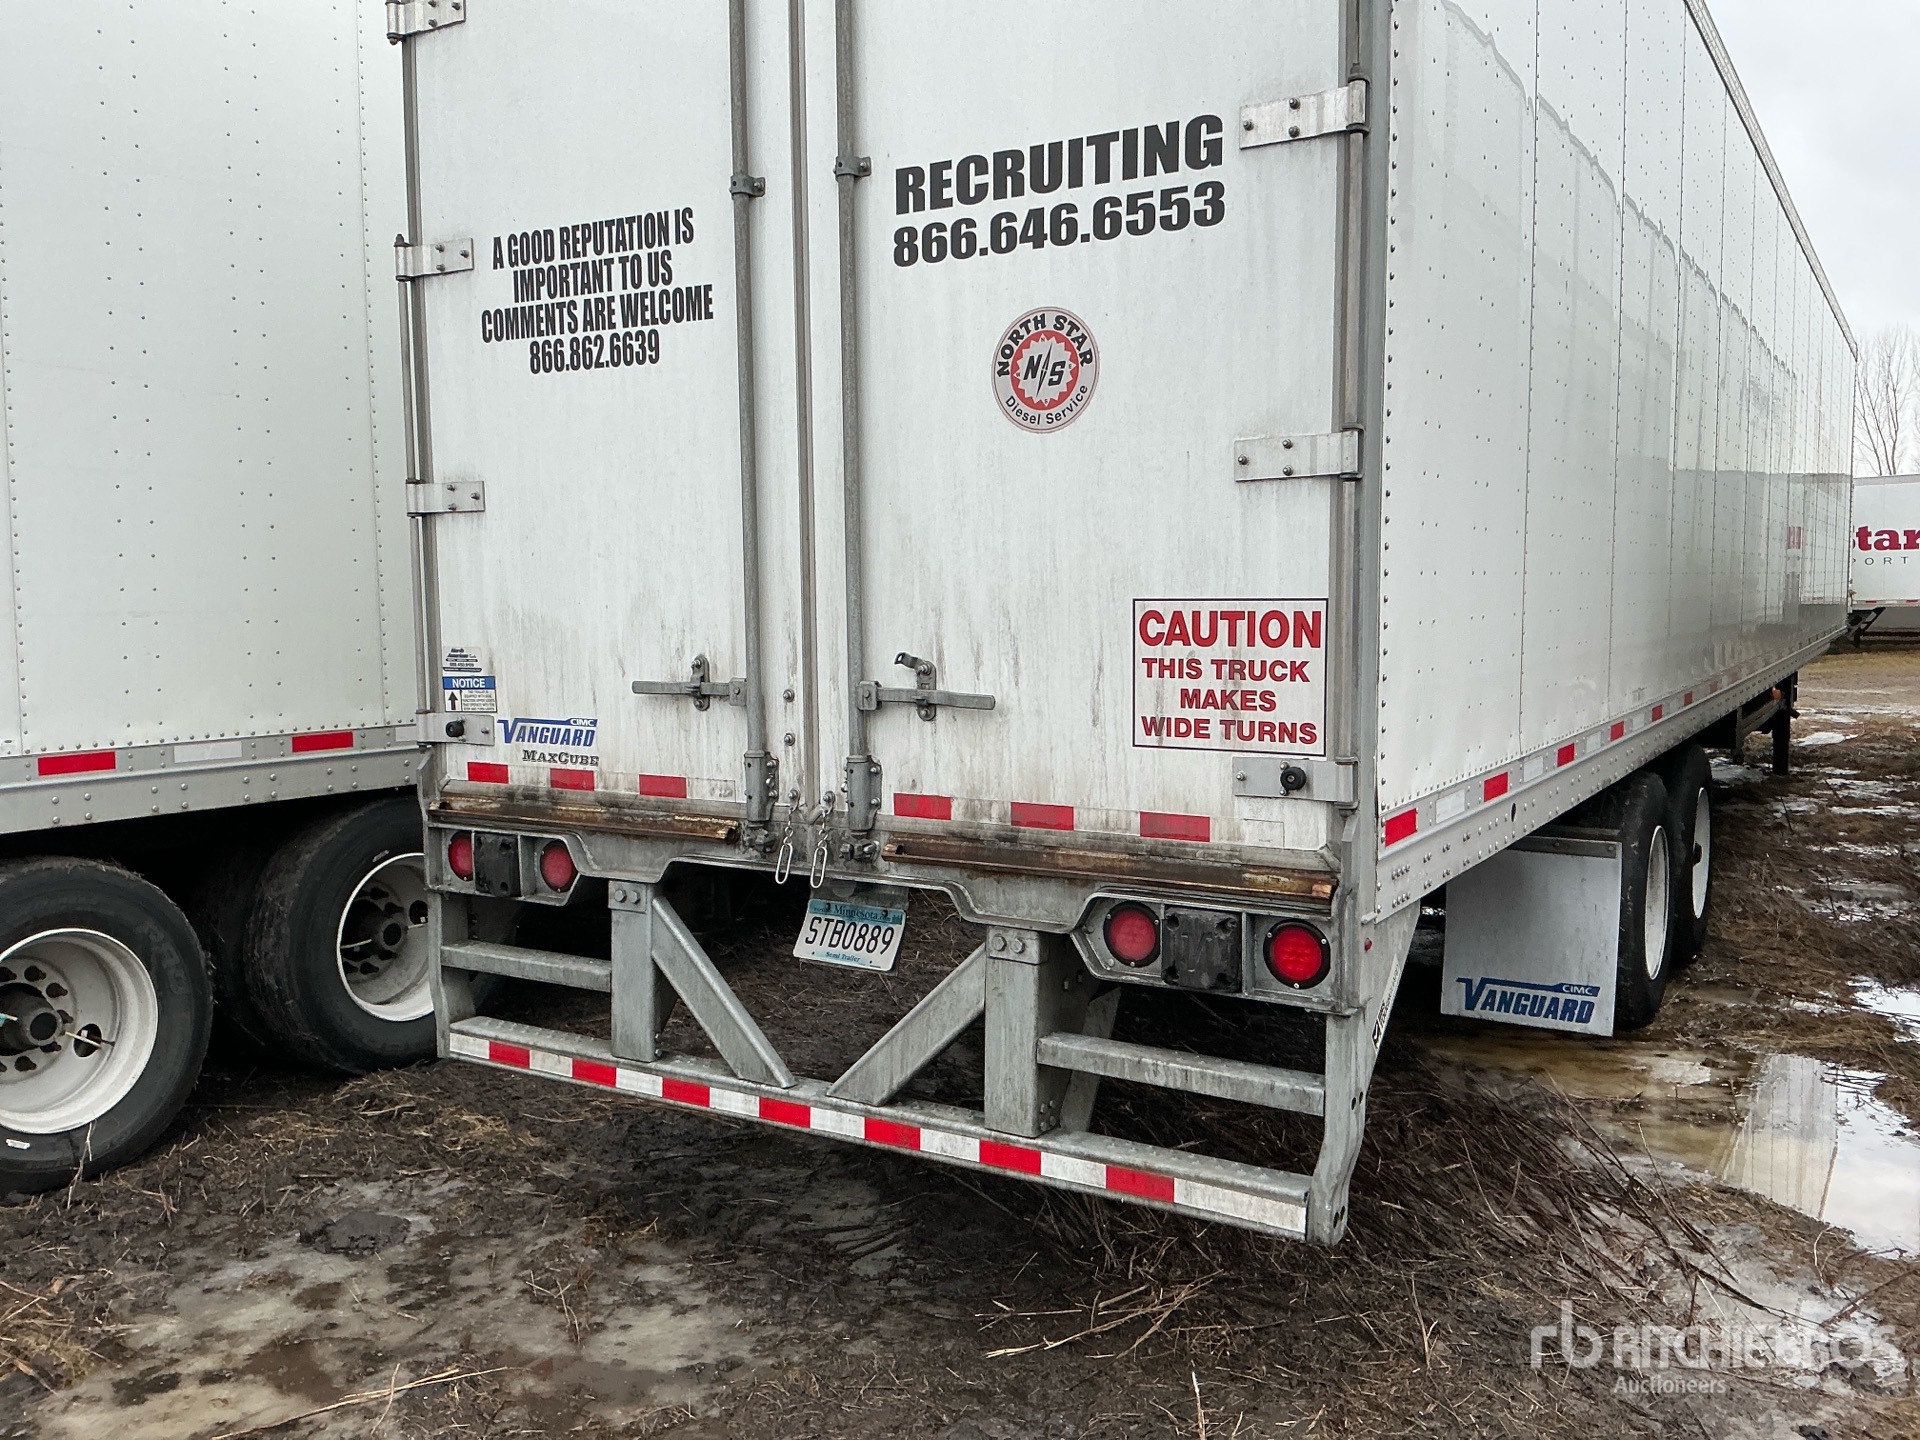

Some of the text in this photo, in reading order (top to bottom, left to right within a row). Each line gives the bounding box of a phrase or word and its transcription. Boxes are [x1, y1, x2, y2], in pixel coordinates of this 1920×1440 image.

[895, 114, 1223, 216] RECRUITING
[492, 207, 694, 270] A GOOD REPUTATION IS
[893, 180, 1225, 267] 866.646.6553
[513, 249, 673, 303] IMPORTANT TO US
[481, 284, 714, 343] COMMENTS ARE WELCOME
[529, 328, 660, 375] 866.862.6639
[996, 313, 1093, 378] NORTH STAR
[1005, 385, 1088, 425] Diesel Service
[1853, 525, 1920, 551] tar
[1139, 609, 1322, 648] CAUTION
[452, 678, 486, 689] NOTICE
[1142, 657, 1311, 683] THIS TRUCK
[1180, 688, 1276, 712] MAKES
[497, 717, 596, 747] VANGUARD
[570, 718, 595, 727] CIMC
[1141, 715, 1317, 744] WIDE TURNS
[805, 916, 894, 955] STB0889
[826, 951, 861, 963] Semi Trailer
[1456, 977, 1600, 1024] VANGUARD
[1562, 984, 1594, 996] CIMC
